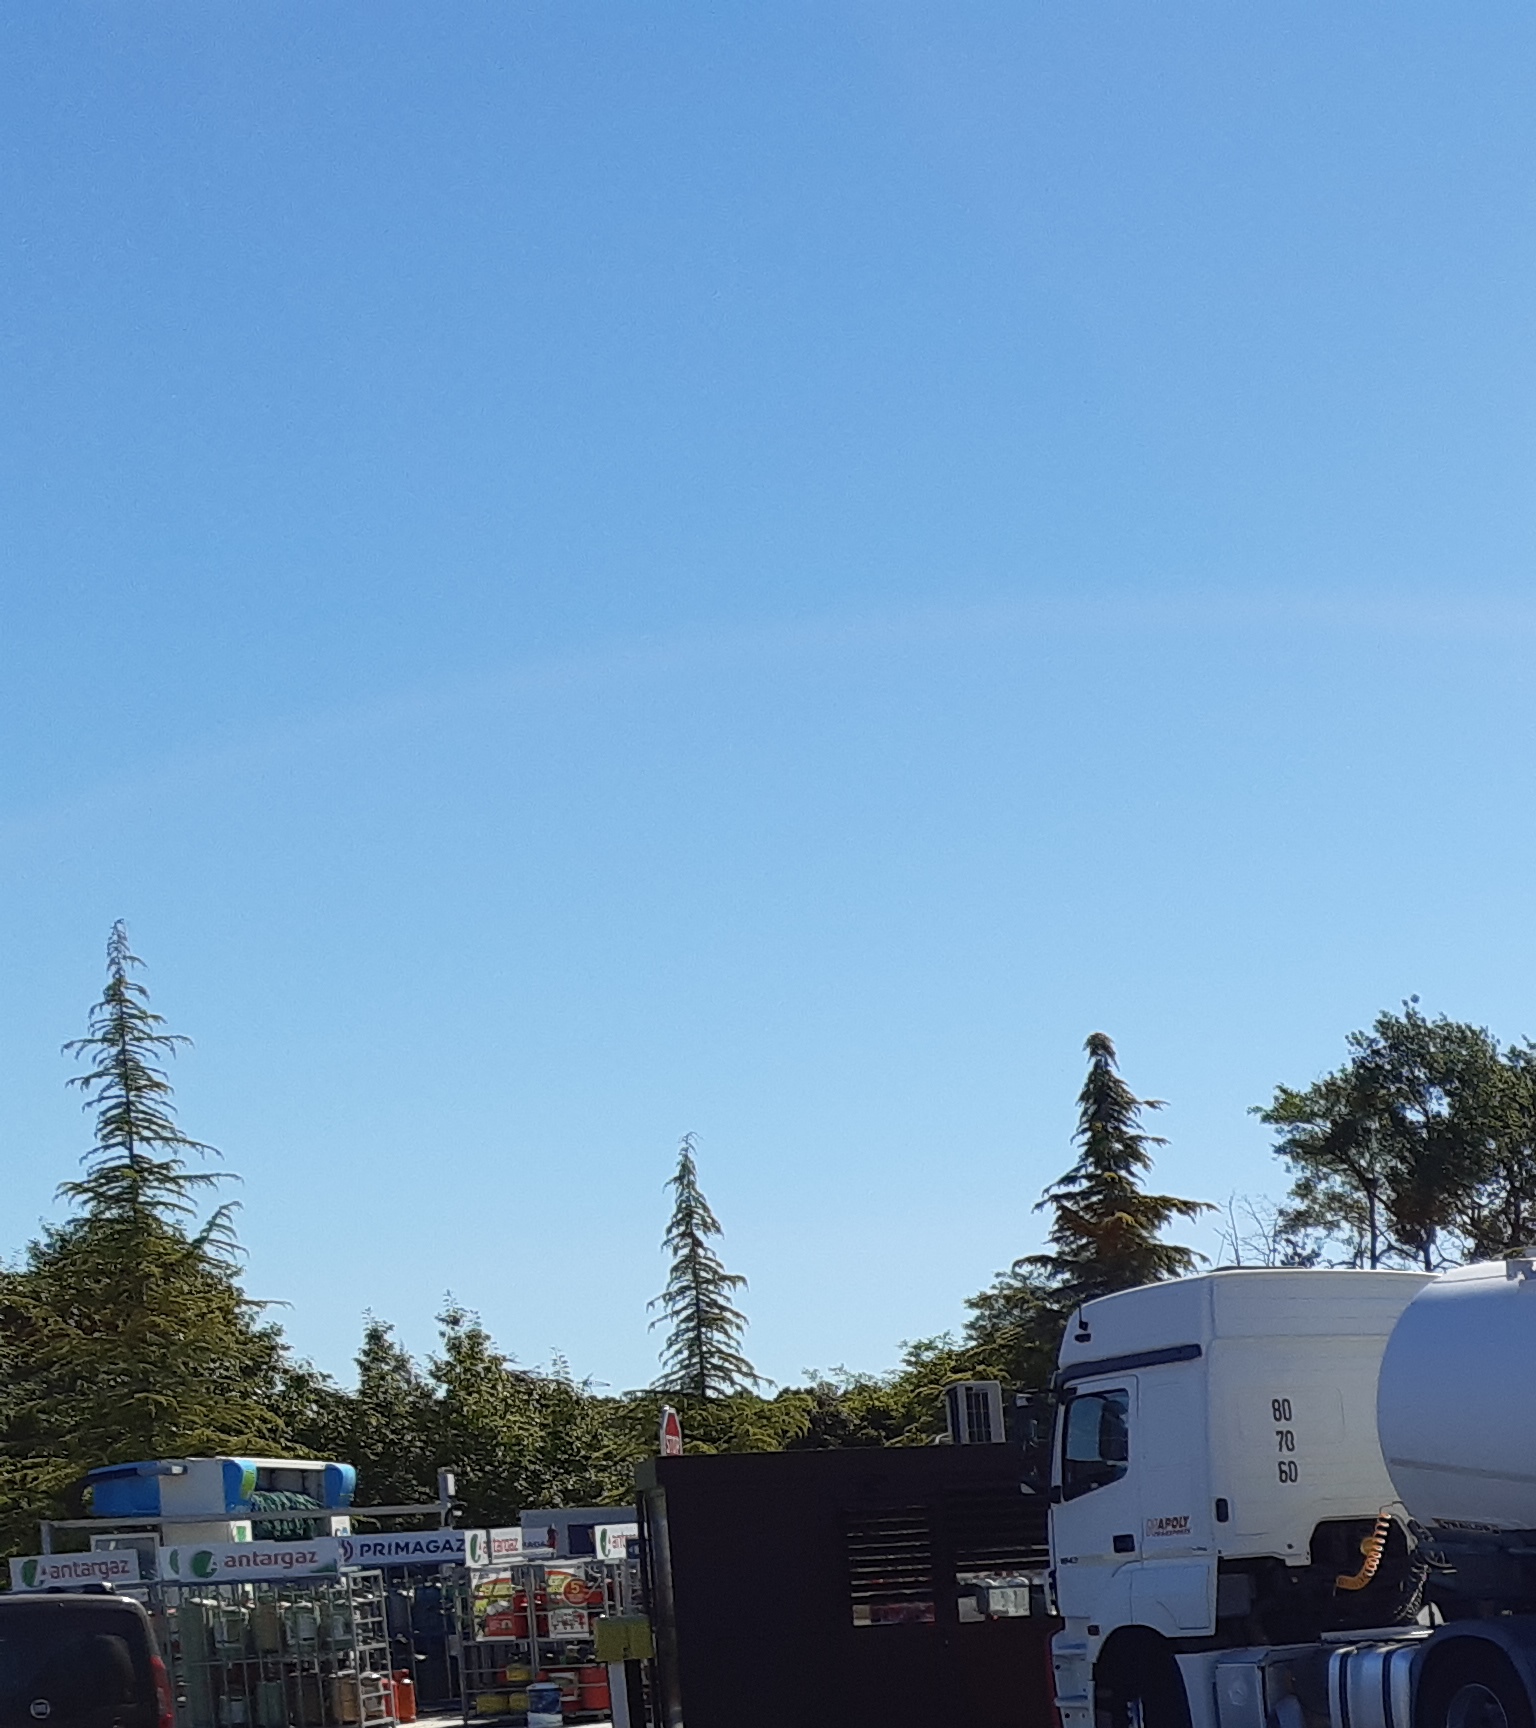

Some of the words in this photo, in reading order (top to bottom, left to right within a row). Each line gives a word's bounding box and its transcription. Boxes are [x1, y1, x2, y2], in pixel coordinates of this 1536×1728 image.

[1271, 1398, 1292, 1422] 80
[1275, 1430, 1295, 1452] 70
[1277, 1460, 1298, 1483] 60
[360, 1538, 465, 1557] PRIMAGAZ
[51, 1559, 130, 1579] antargaz
[224, 1551, 318, 1569] antargaz
